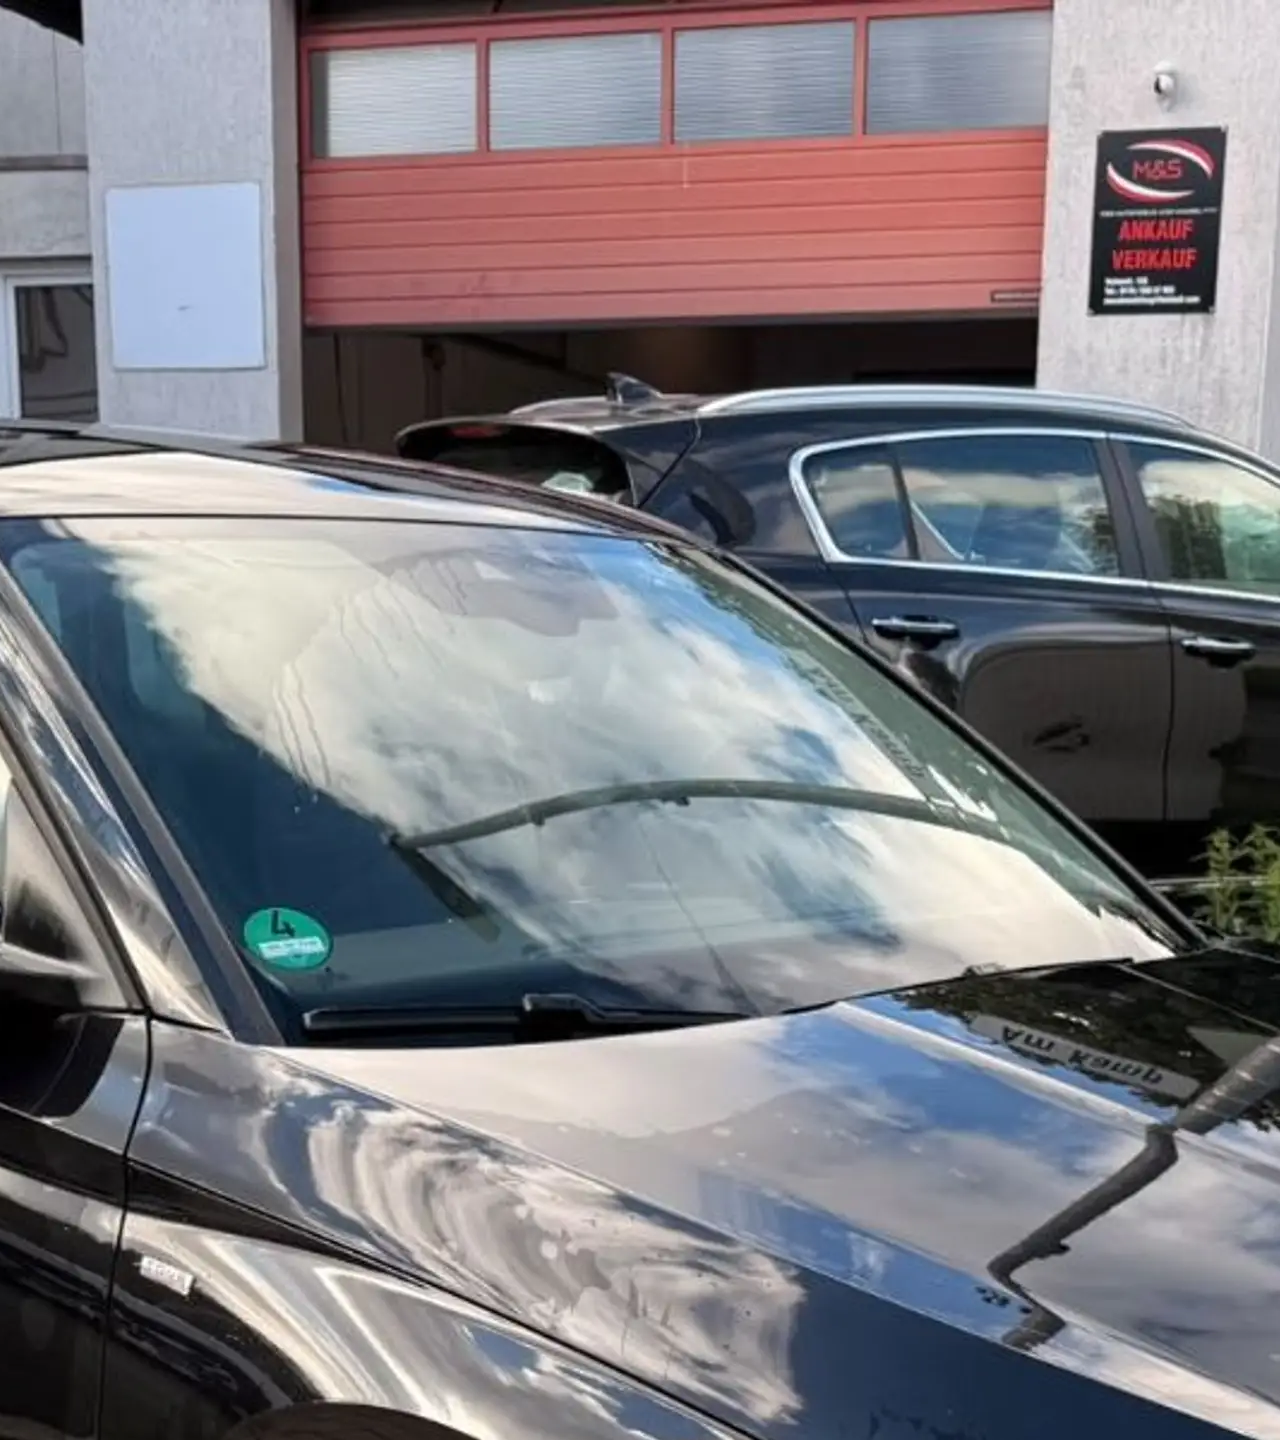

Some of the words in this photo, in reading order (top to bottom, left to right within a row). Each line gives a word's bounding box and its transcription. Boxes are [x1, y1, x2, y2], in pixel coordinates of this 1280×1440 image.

[1132, 158, 1184, 181] M&S
[1119, 219, 1194, 241] ANKAUF
[1112, 248, 1198, 270] VERKAUF
[271, 910, 295, 937] 4
